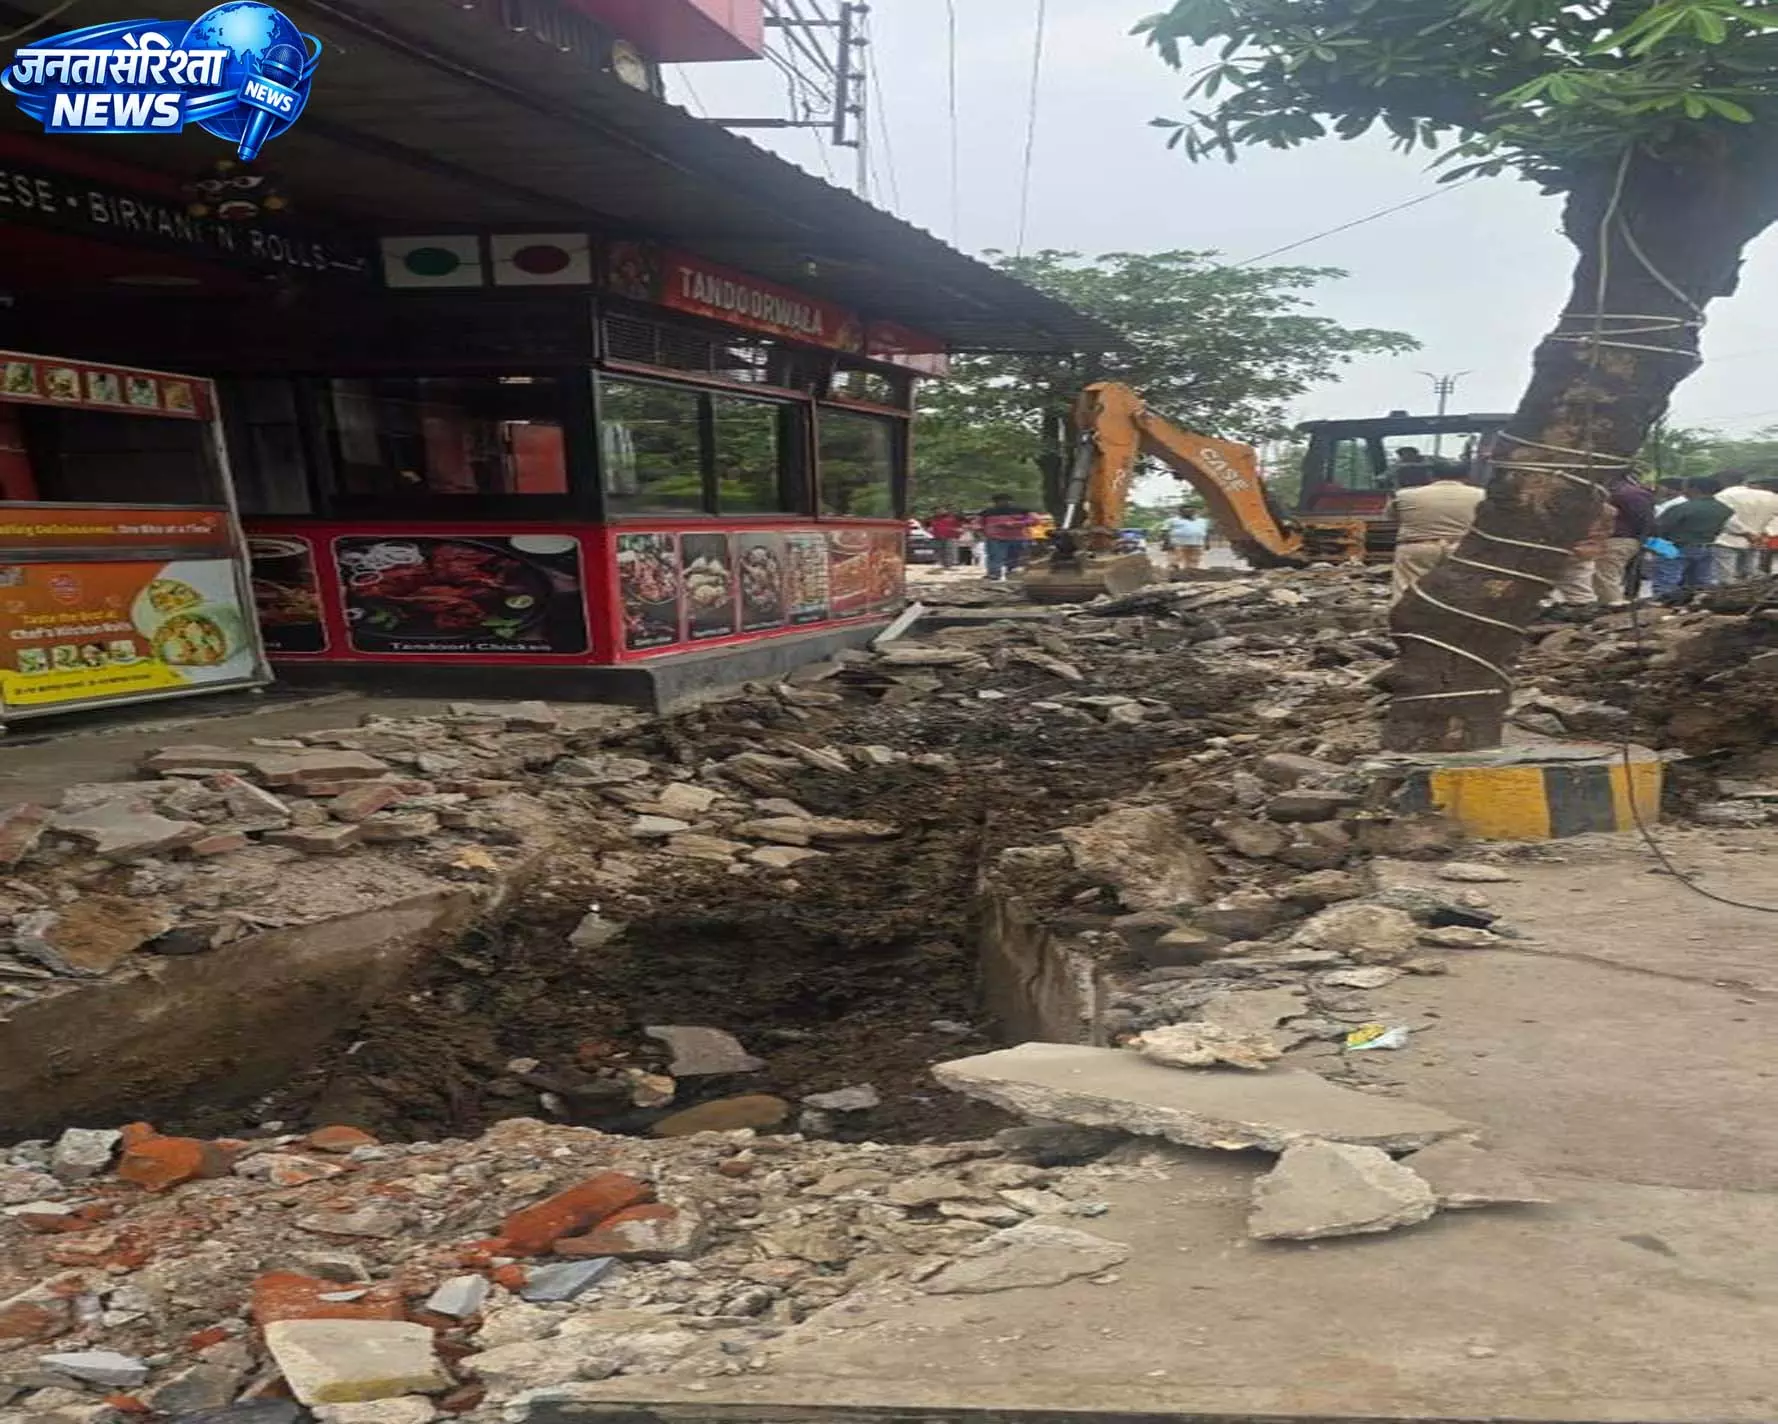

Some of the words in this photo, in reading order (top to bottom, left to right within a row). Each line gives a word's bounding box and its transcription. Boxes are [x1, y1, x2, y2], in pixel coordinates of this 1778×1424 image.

[248, 228, 327, 271] ROLLS
[677, 266, 824, 337] TANDOORWALA
[1199, 447, 1249, 492] CASE
